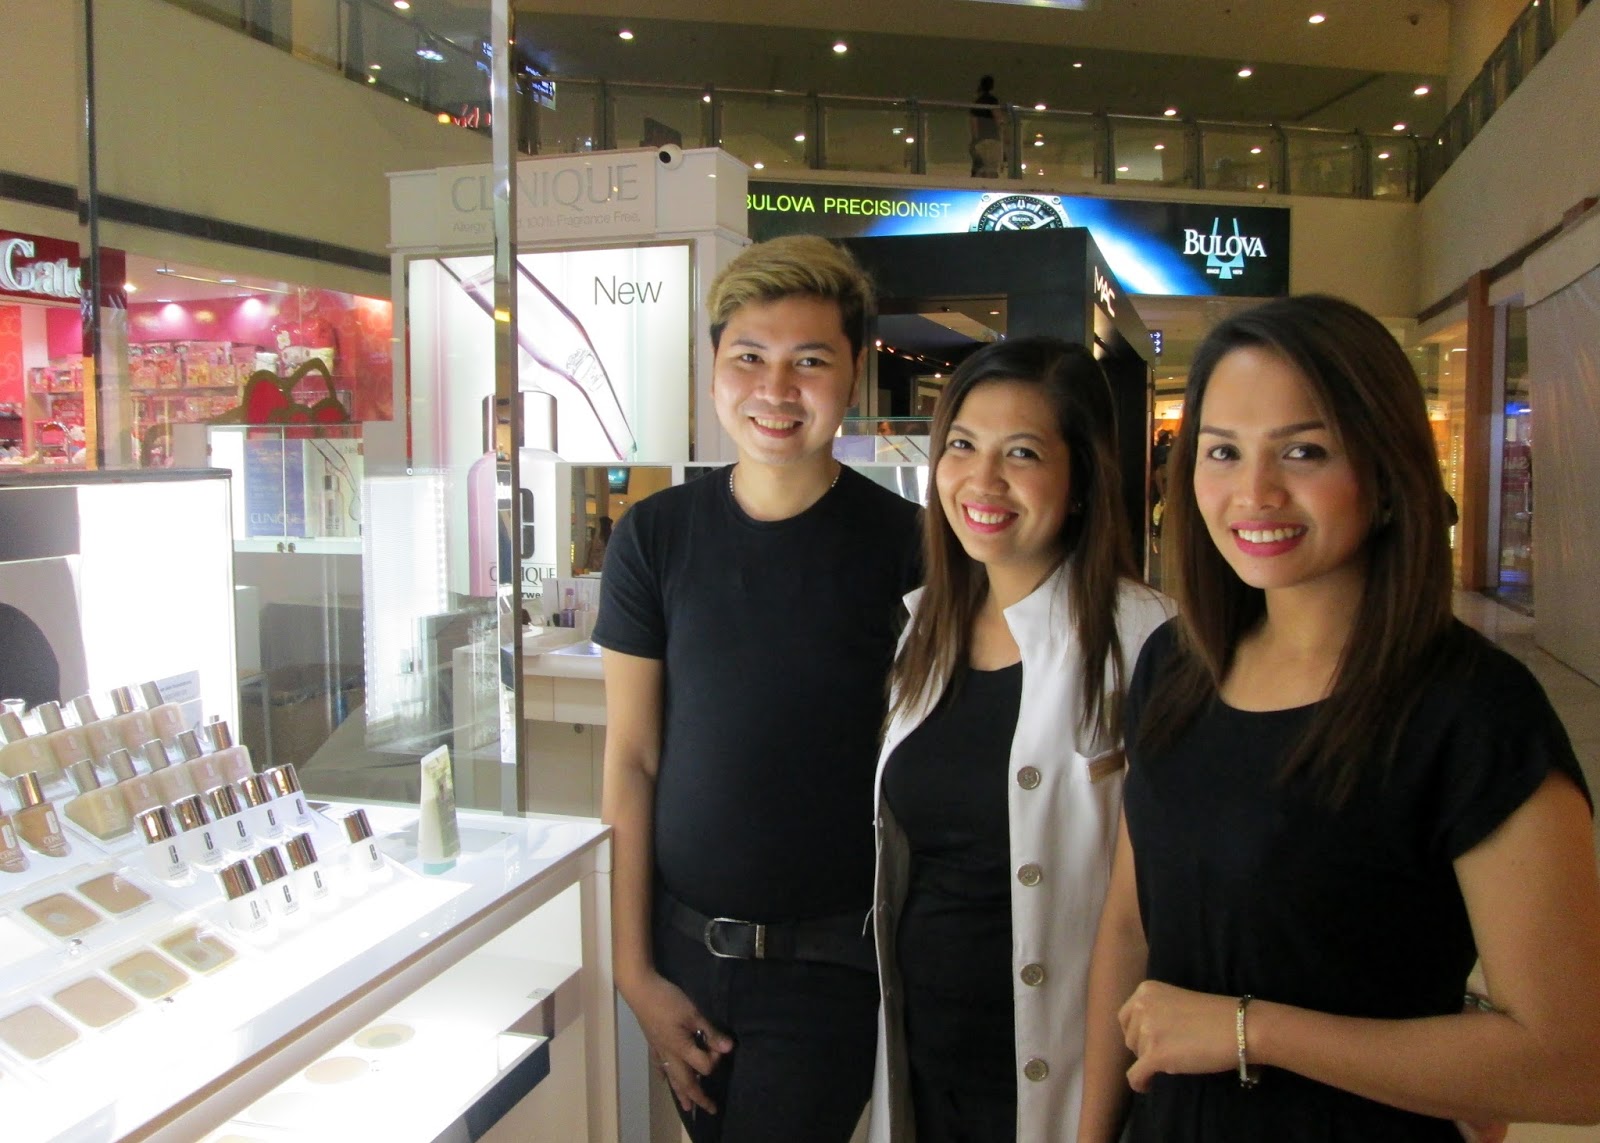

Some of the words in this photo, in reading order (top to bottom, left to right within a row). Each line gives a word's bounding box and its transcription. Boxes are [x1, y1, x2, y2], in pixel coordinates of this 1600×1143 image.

[451, 163, 640, 213] CLNIQUE
[824, 197, 951, 218] PRECISIONIST
[1183, 228, 1267, 257] BULOVA
[594, 275, 663, 306] New
[489, 566, 556, 586] CIQUE
